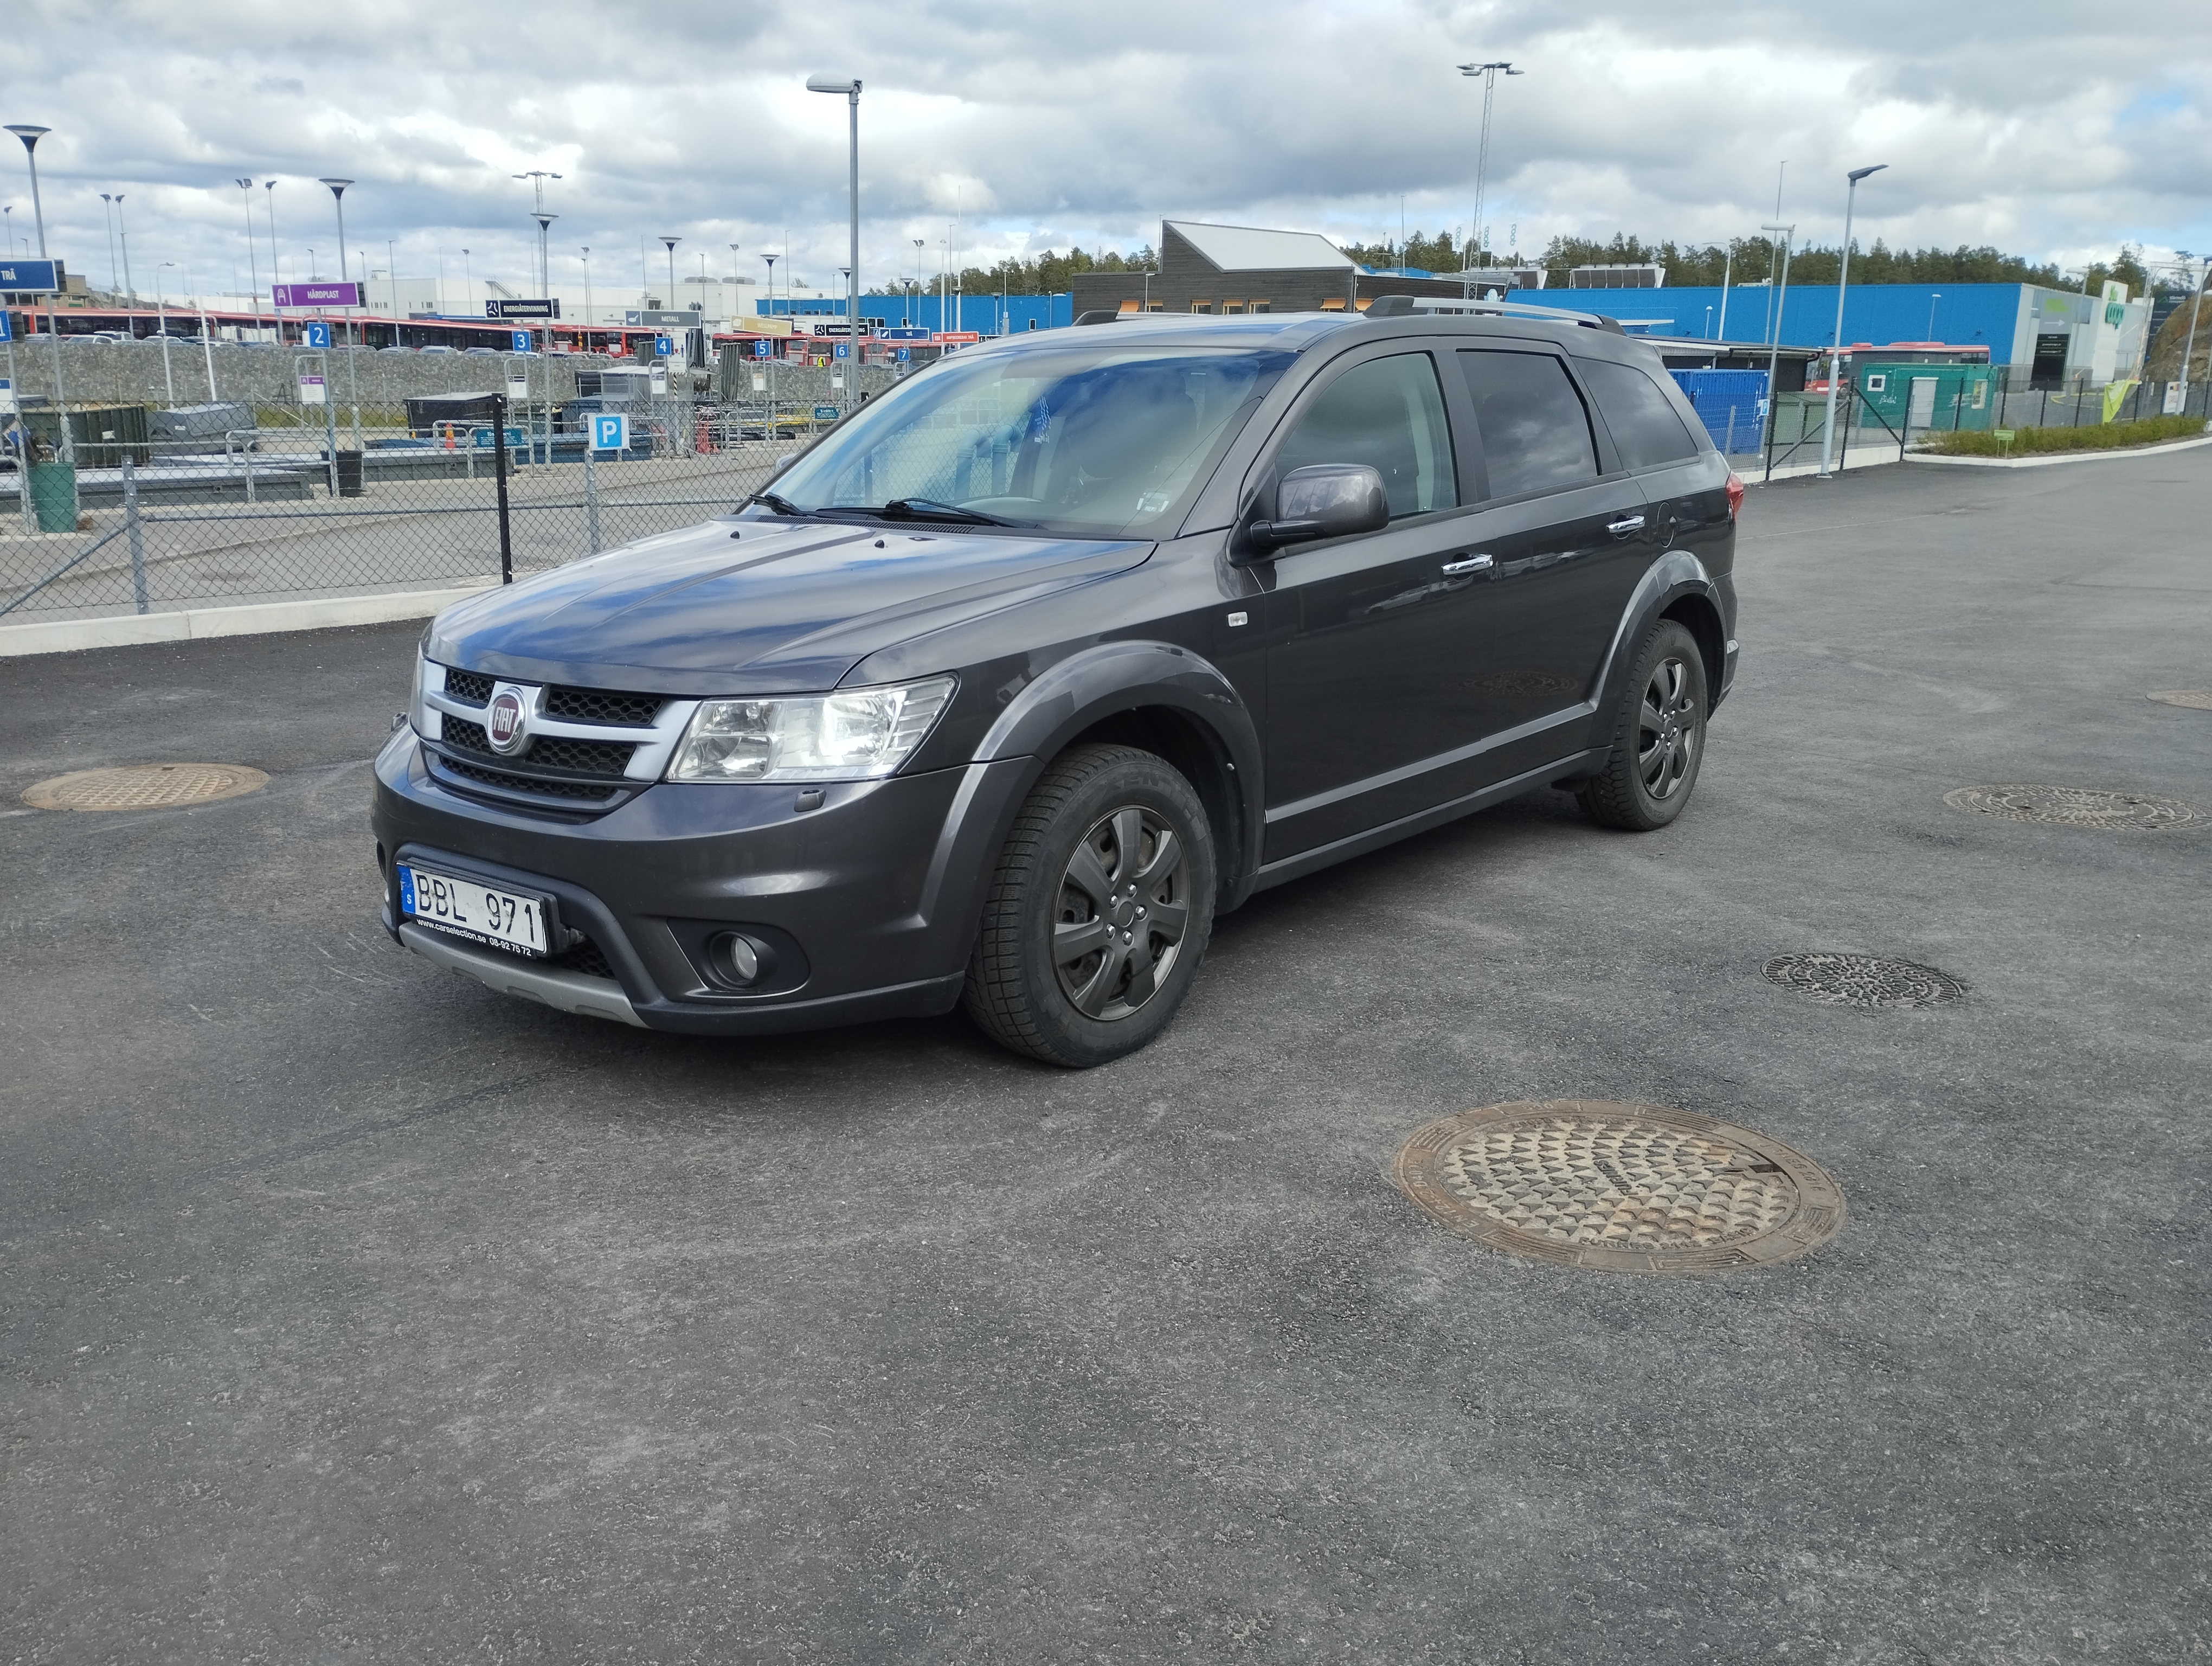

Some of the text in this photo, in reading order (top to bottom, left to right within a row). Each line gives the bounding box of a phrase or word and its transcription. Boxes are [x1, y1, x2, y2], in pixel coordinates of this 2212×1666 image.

[1, 267, 16, 280] TRÄ
[307, 289, 339, 299] HÅRDPLAST
[503, 303, 549, 312] ENERGIÅTERVINNING
[314, 327, 324, 344] 2
[517, 334, 526, 348] 3
[659, 340, 667, 353] 4
[760, 344, 766, 354] 5
[839, 347, 845, 356] 6
[901, 350, 907, 359] 7
[602, 421, 617, 444] P
[493, 706, 517, 733] FIAT
[407, 894, 411, 905] S
[416, 874, 535, 943] BBL 971
[416, 918, 532, 957] www.carselection.se 08-92 75 72
[1593, 1159, 1639, 1196] FURNES
